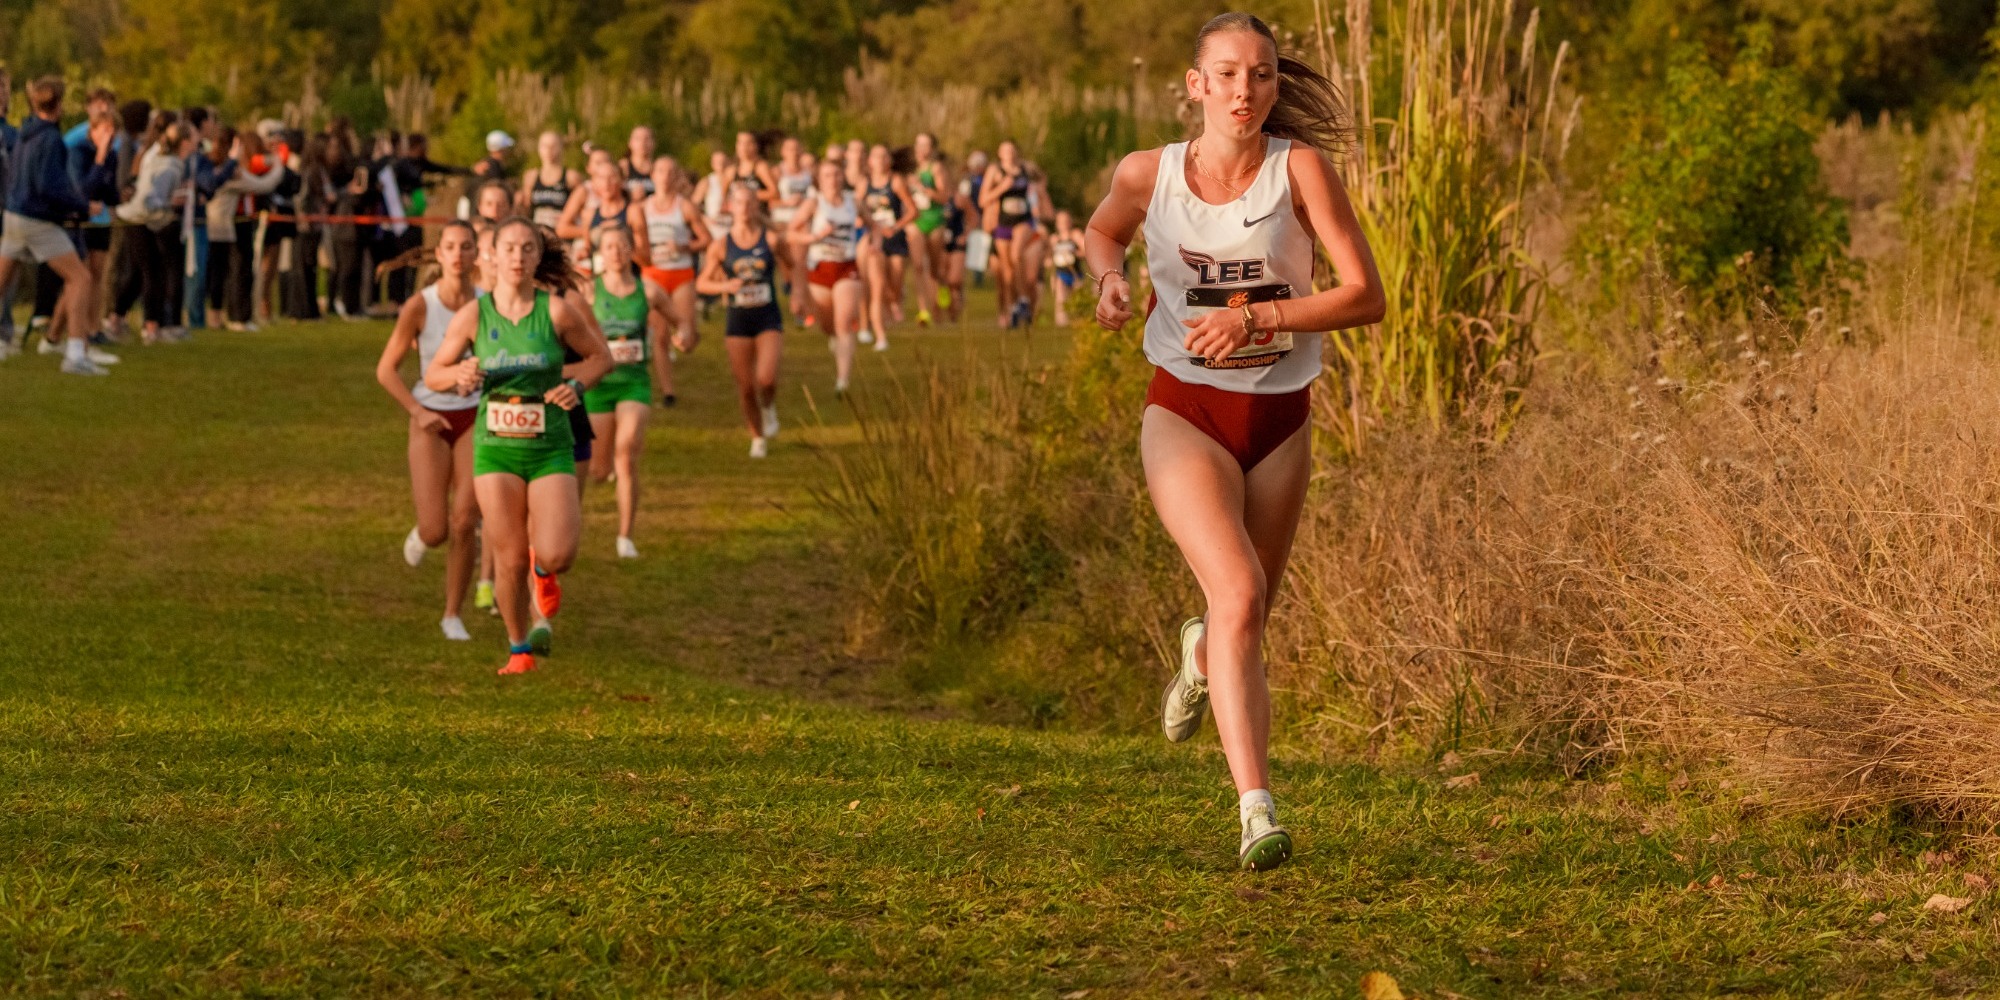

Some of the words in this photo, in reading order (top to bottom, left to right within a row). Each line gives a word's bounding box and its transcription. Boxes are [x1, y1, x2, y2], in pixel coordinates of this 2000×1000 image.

[1198, 259, 1265, 285] LEE
[1204, 354, 1280, 369] CHAMPIONSHIPS
[491, 409, 541, 427] 1062
